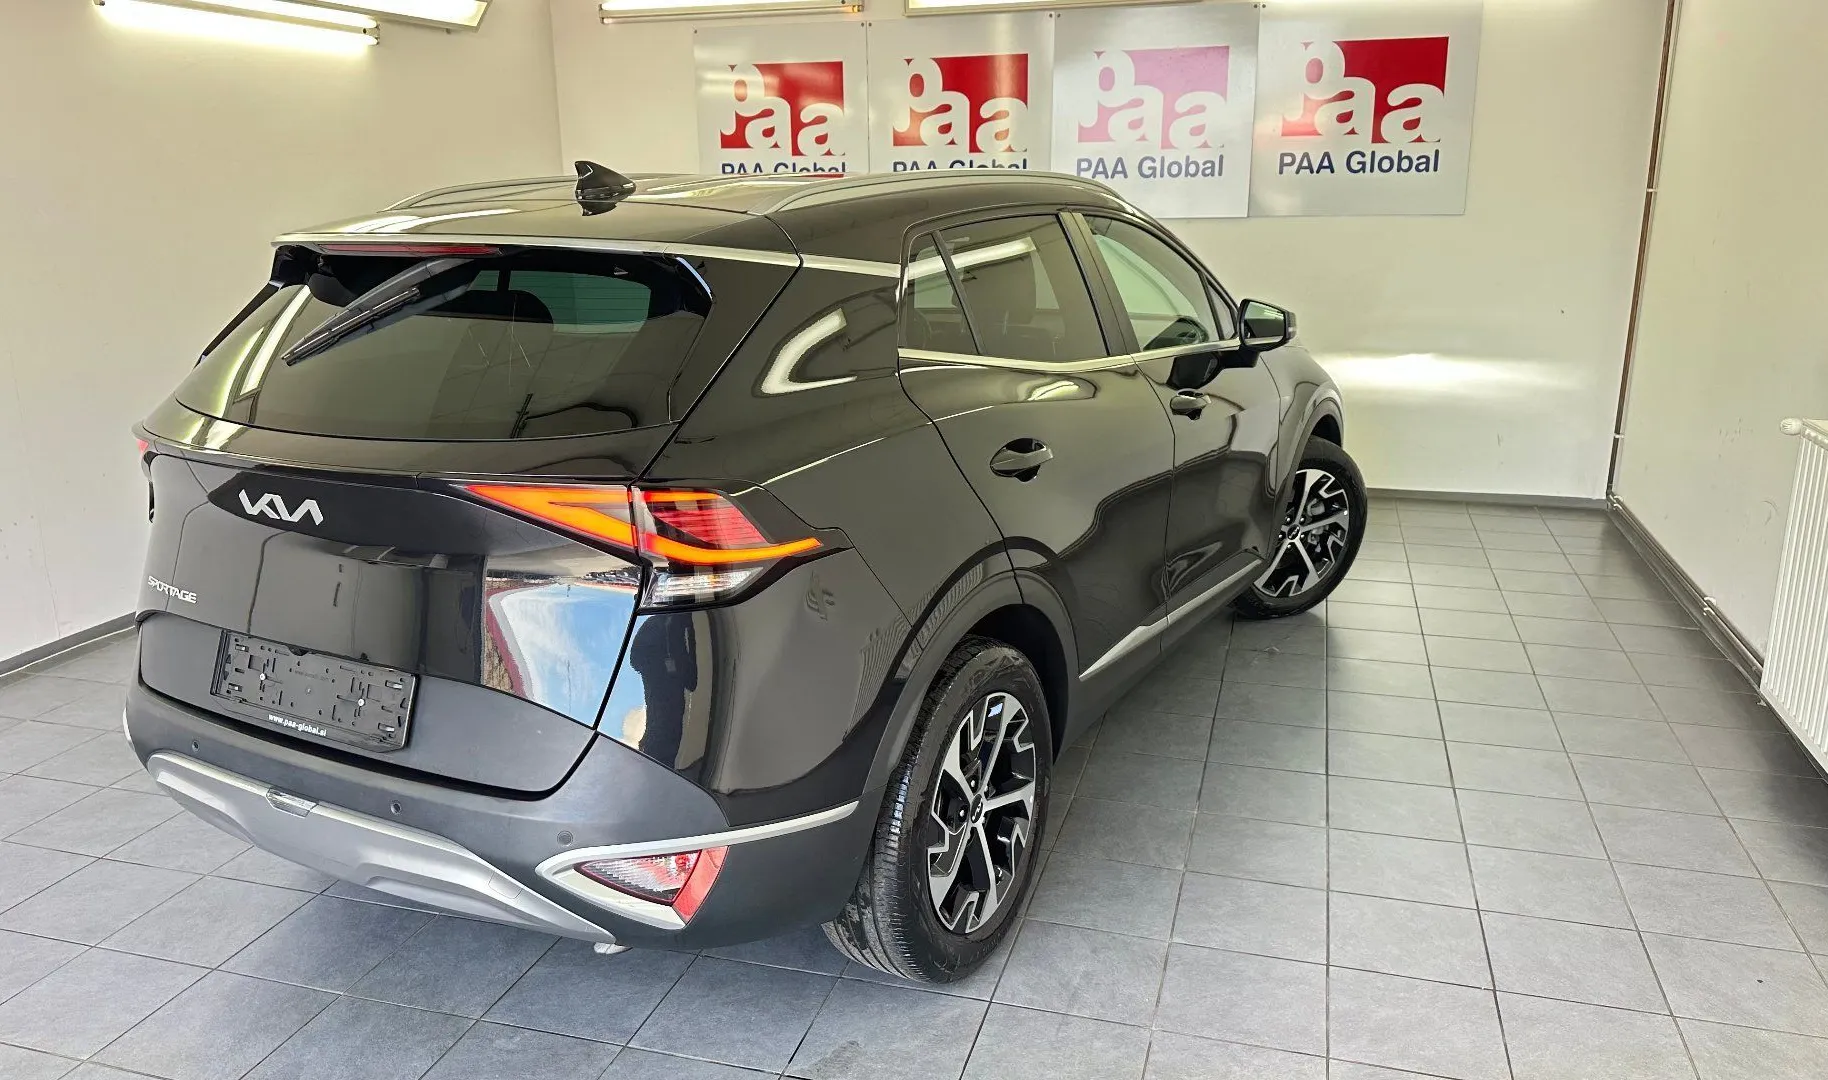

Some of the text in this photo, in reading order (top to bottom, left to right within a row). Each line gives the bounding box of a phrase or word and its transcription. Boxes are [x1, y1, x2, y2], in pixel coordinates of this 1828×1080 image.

[1076, 154, 1224, 179] PAA Global
[1278, 149, 1440, 175] PAA Global
[147, 575, 197, 604] SPORTAGE
[268, 713, 327, 737] www.paa-global.si
